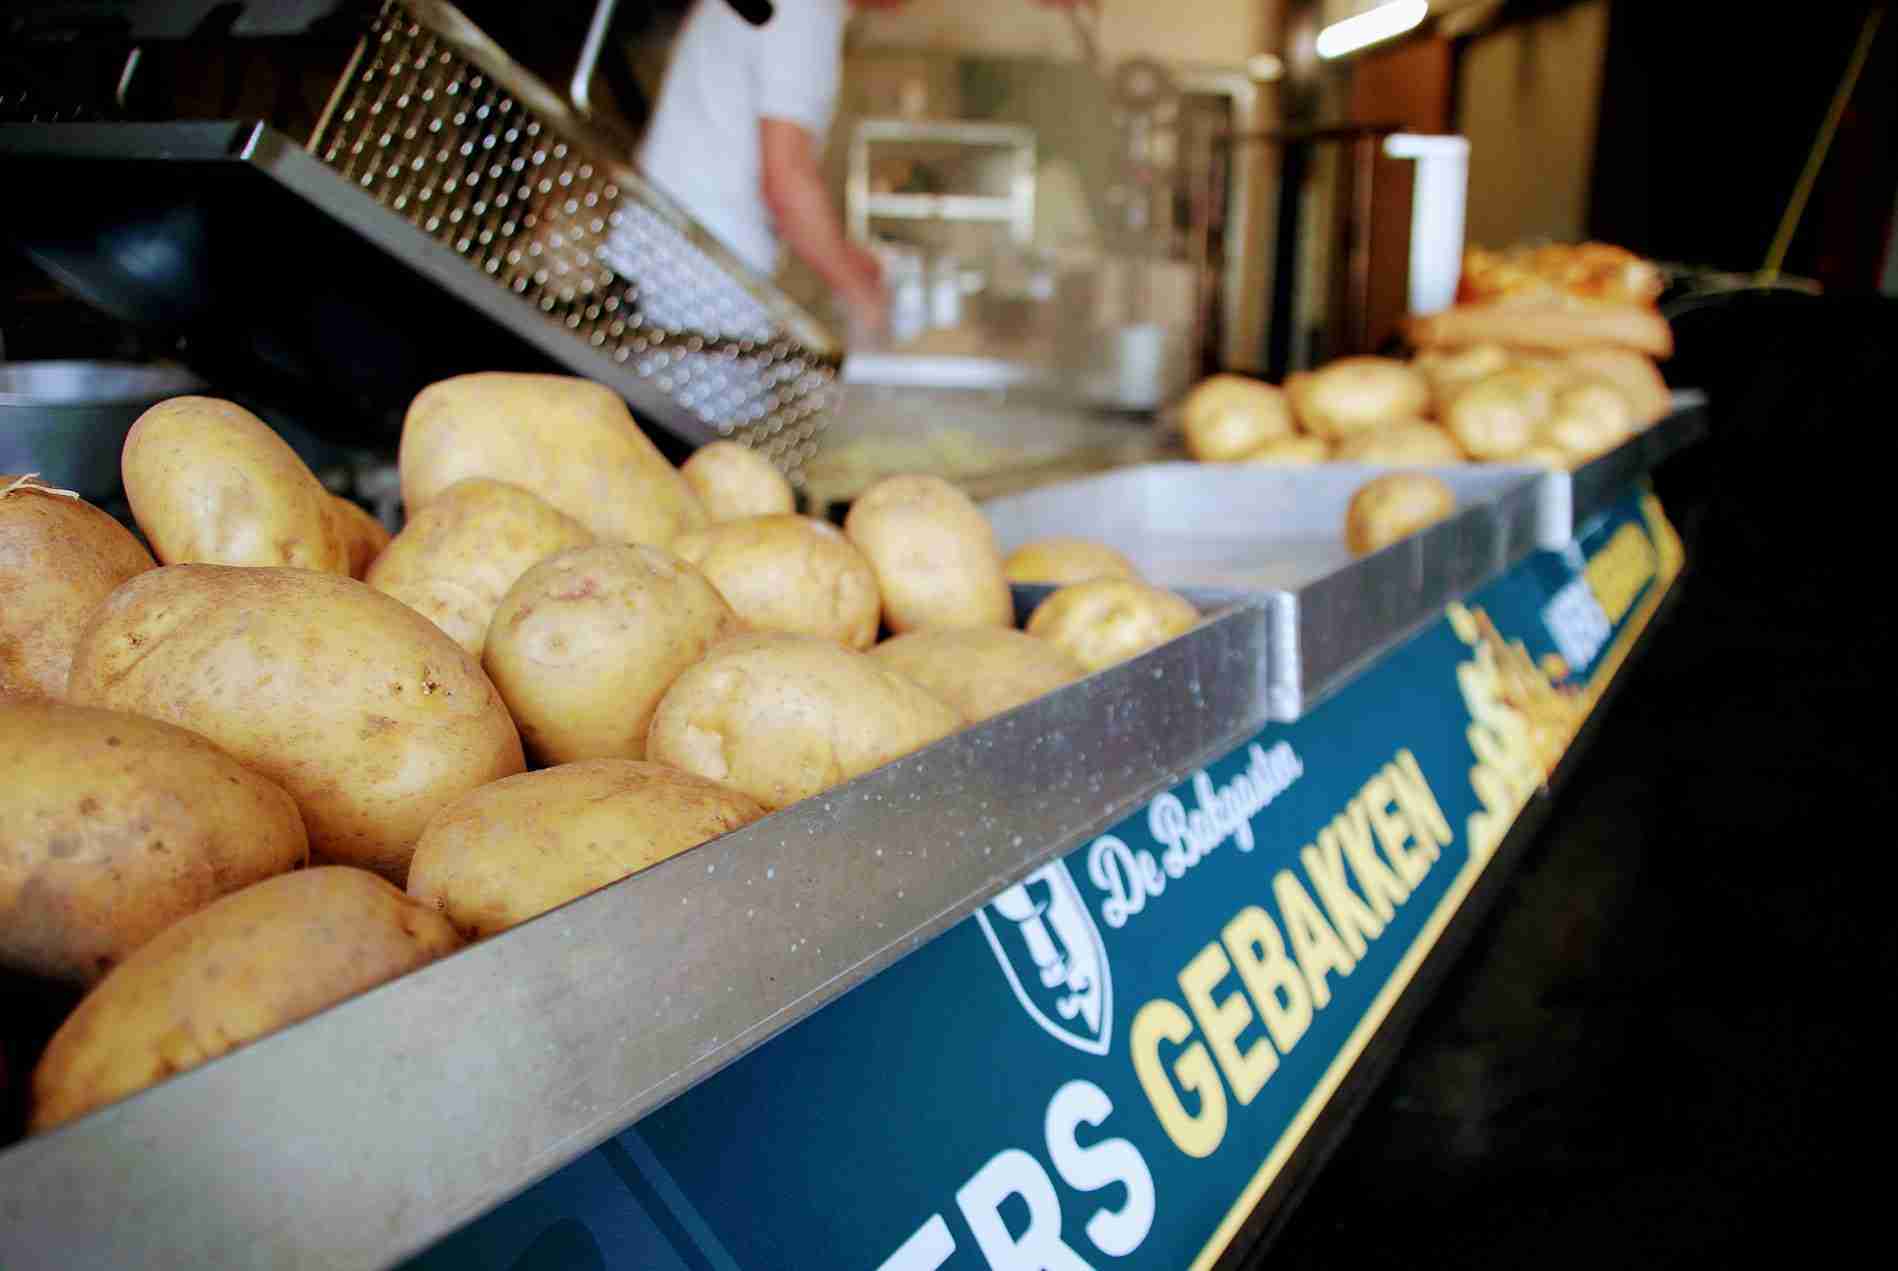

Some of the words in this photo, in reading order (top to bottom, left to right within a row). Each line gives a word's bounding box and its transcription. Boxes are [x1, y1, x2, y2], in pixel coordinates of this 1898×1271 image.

[875, 1078, 1156, 1271] RS
[1130, 747, 1454, 1158] GEBAKKEN
[1087, 834, 1166, 928] De
